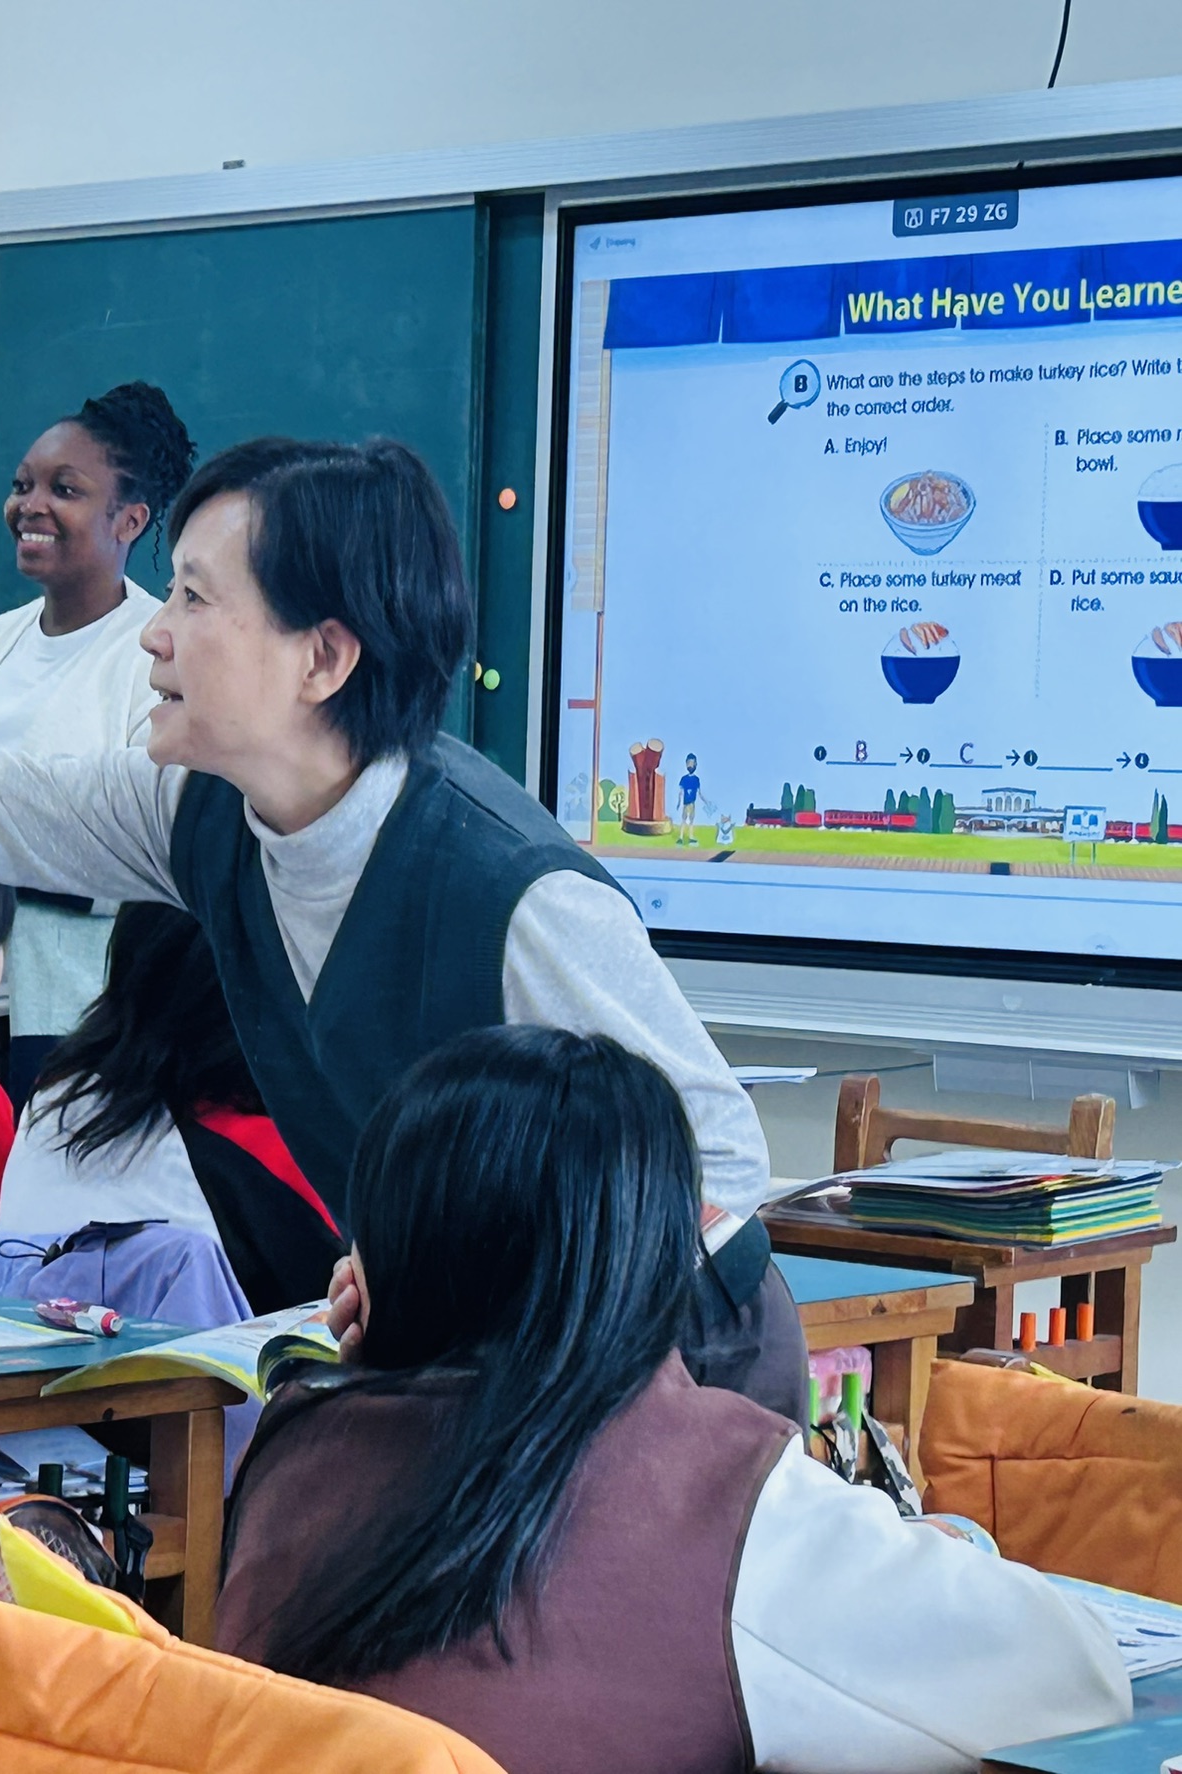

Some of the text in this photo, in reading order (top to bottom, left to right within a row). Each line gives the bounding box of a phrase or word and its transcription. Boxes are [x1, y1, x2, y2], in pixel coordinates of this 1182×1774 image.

[930, 202, 1008, 226] F7 29 ZG
[847, 278, 1182, 323] What Have You Learne
[826, 373, 865, 390] What
[868, 374, 894, 388] are
[898, 371, 923, 386] the
[926, 370, 966, 387] steps
[969, 367, 986, 383] to
[989, 365, 1033, 382] make
[1039, 363, 1085, 382] turkey
[1089, 360, 1127, 378] rice?
[1132, 358, 1172, 376] Write
[826, 396, 955, 417] the correct order.
[823, 436, 888, 456] A. Enjoy!
[1077, 428, 1123, 445] Place
[1126, 429, 1172, 443] some
[1075, 454, 1118, 473] bowl.
[818, 569, 1022, 589] C. Place some turkey meat
[1049, 569, 1065, 585] D.
[1072, 568, 1096, 585] Put
[1100, 571, 1145, 585] some
[839, 596, 923, 613] on the rice.
[1070, 594, 1105, 612] rice.
[959, 742, 974, 765] C
